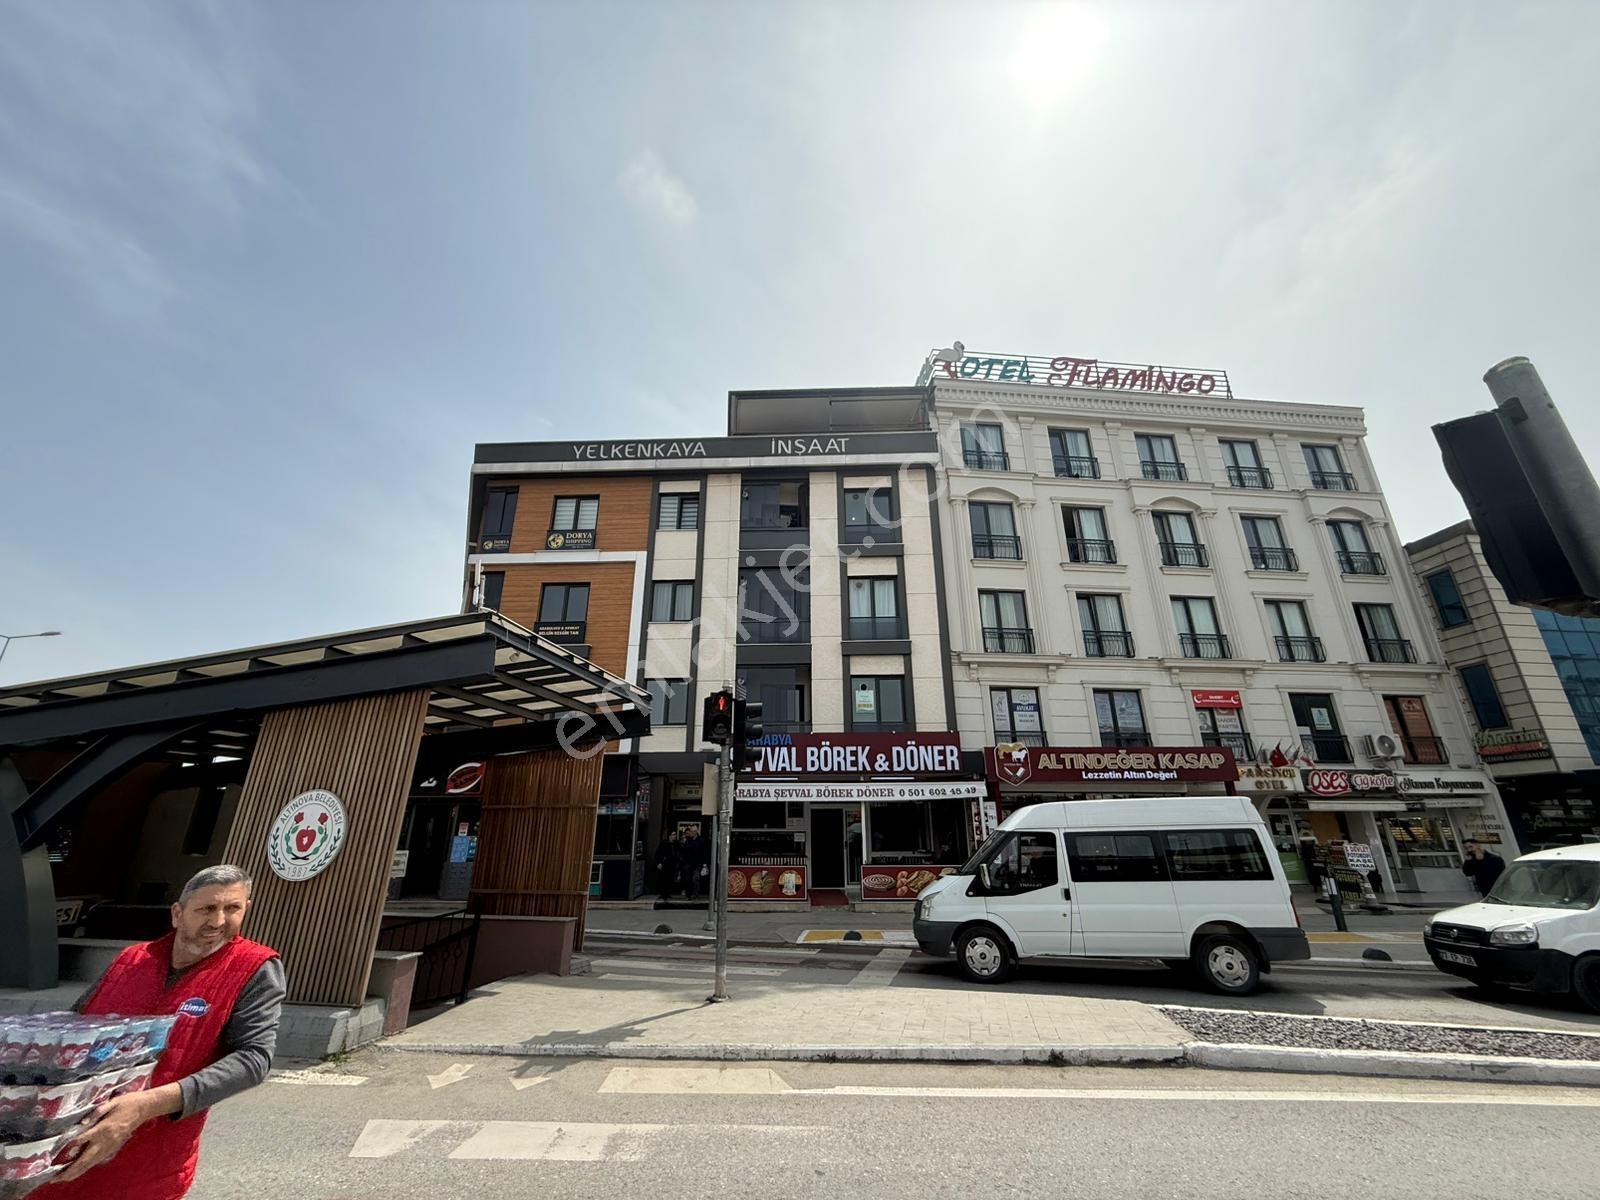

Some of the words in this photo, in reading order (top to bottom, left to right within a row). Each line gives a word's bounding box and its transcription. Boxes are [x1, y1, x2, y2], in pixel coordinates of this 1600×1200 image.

[960, 357, 1035, 381] OTEL
[573, 441, 707, 459] YELKENKAYA
[771, 437, 850, 456] İNŞAAT
[748, 733, 792, 746] ARABYA
[806, 740, 871, 772] BÖREK
[874, 753, 890, 772] &
[892, 740, 960, 771] DÖNER
[1038, 749, 1157, 770] ALTINDEĞER
[1157, 753, 1225, 769] KASAP
[1082, 770, 1122, 779] Lezzetin
[1123, 770, 1145, 779] Altın
[1146, 770, 1178, 781] Değeri
[734, 788, 771, 798] ARABYA
[773, 787, 814, 800] ŞEVVAL
[816, 785, 854, 798] BÖREK
[857, 785, 895, 798] DÖNER
[898, 789, 906, 797] 0
[908, 788, 926, 797] 501
[929, 788, 947, 796] 602
[280, 794, 314, 824] ALTINOVA
